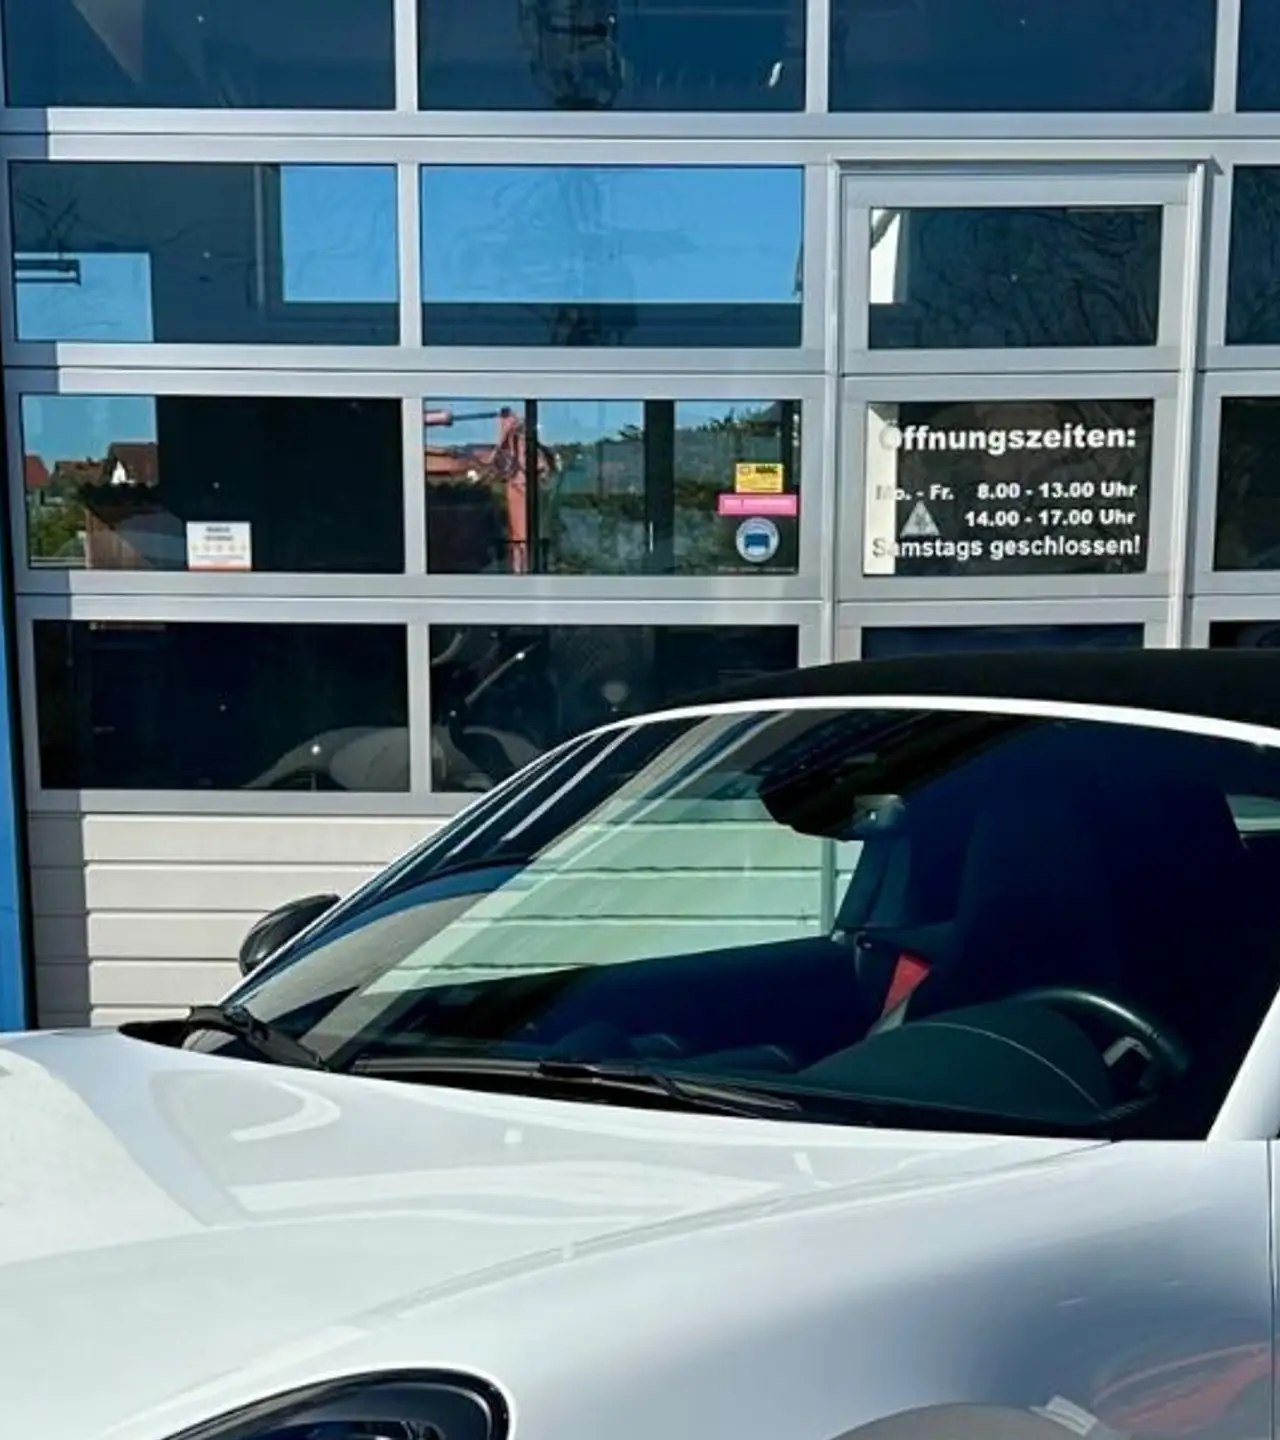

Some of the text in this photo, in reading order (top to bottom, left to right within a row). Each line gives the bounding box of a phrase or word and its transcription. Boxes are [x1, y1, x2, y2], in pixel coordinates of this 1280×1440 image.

[879, 419, 1137, 456] Öffnungszeiten:
[930, 485, 954, 500] Fr.
[977, 483, 1021, 499] 8.00
[1038, 482, 1095, 498] 13.00
[1100, 481, 1138, 498] Uhr
[964, 510, 1020, 527] 14.00
[1038, 509, 1093, 526] 17.00
[1099, 509, 1137, 526] Uhr
[872, 534, 1142, 561] Samstags geschlossen!
